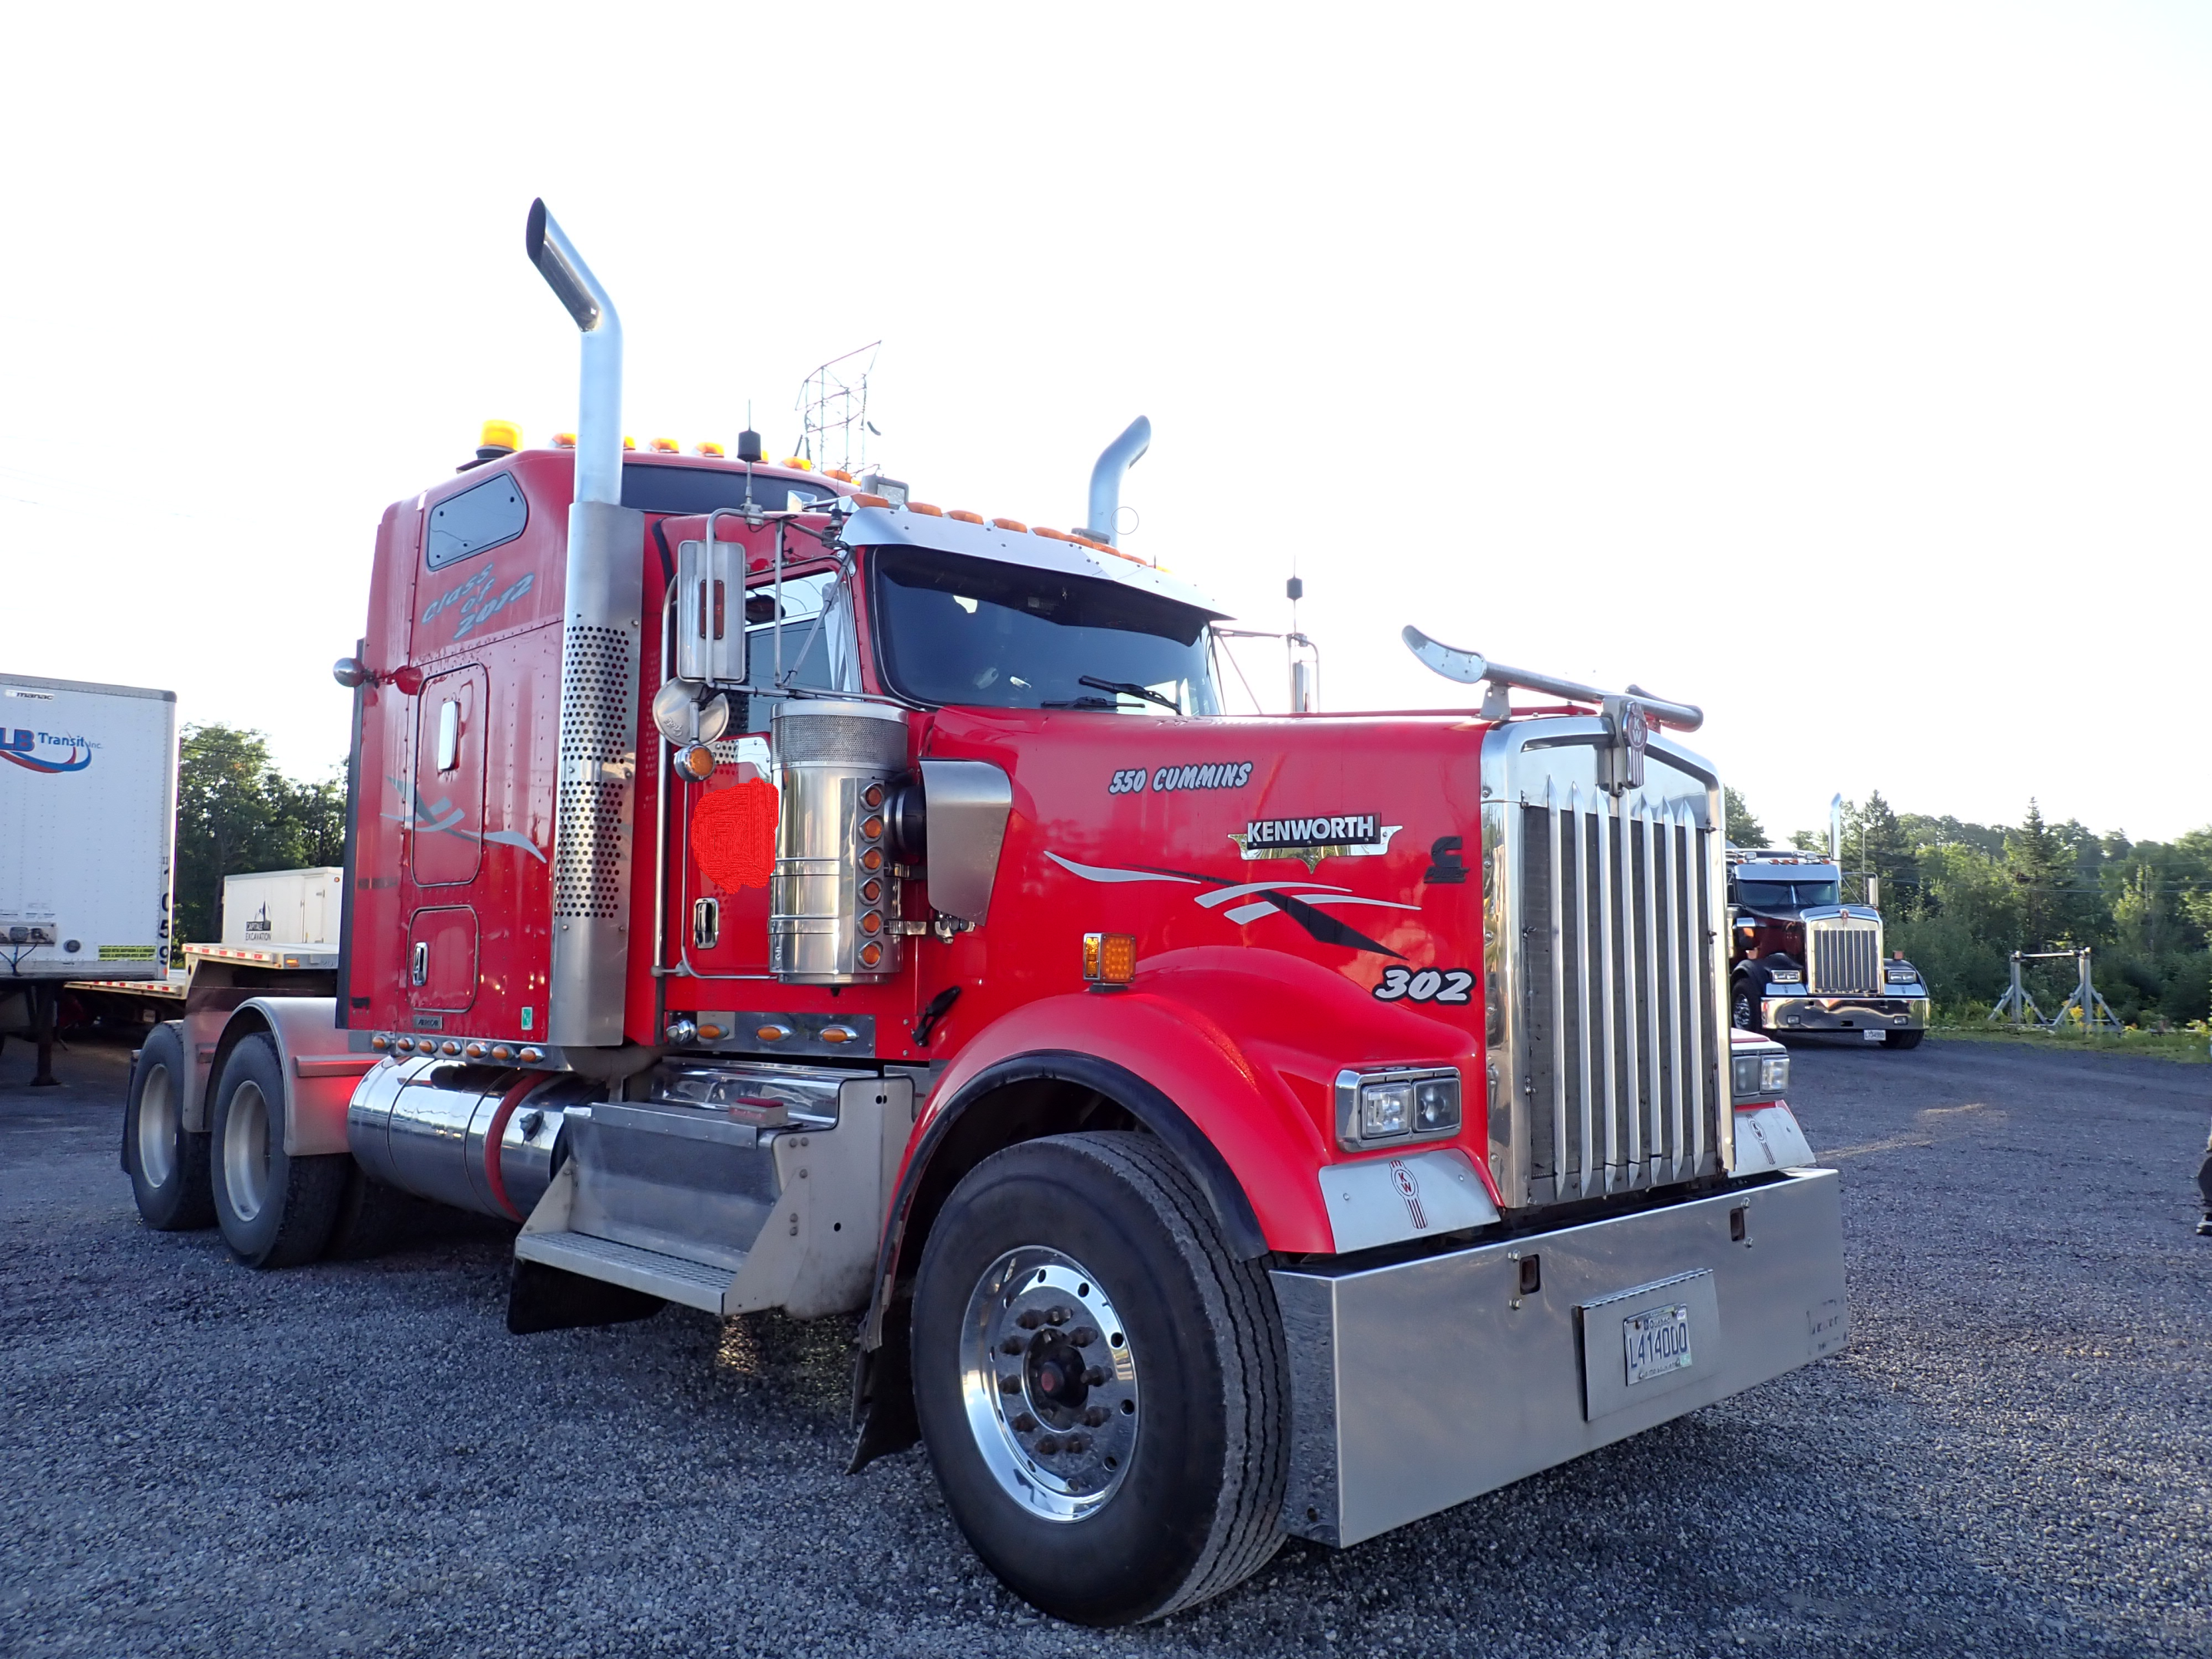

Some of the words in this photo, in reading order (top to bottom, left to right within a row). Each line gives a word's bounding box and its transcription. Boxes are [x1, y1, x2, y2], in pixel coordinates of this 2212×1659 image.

[452, 572, 535, 640] 2012
[461, 578, 495, 614] of
[16, 692, 54, 700] manac
[38, 732, 84, 747] Transit
[1109, 769, 1147, 794] 550
[1152, 761, 1253, 793] CUMMINS
[1247, 815, 1374, 843] KENWORTH
[245, 932, 271, 941] EXCAVATION
[1373, 967, 1475, 1003] 302
[1629, 1322, 1687, 1368] L414000
